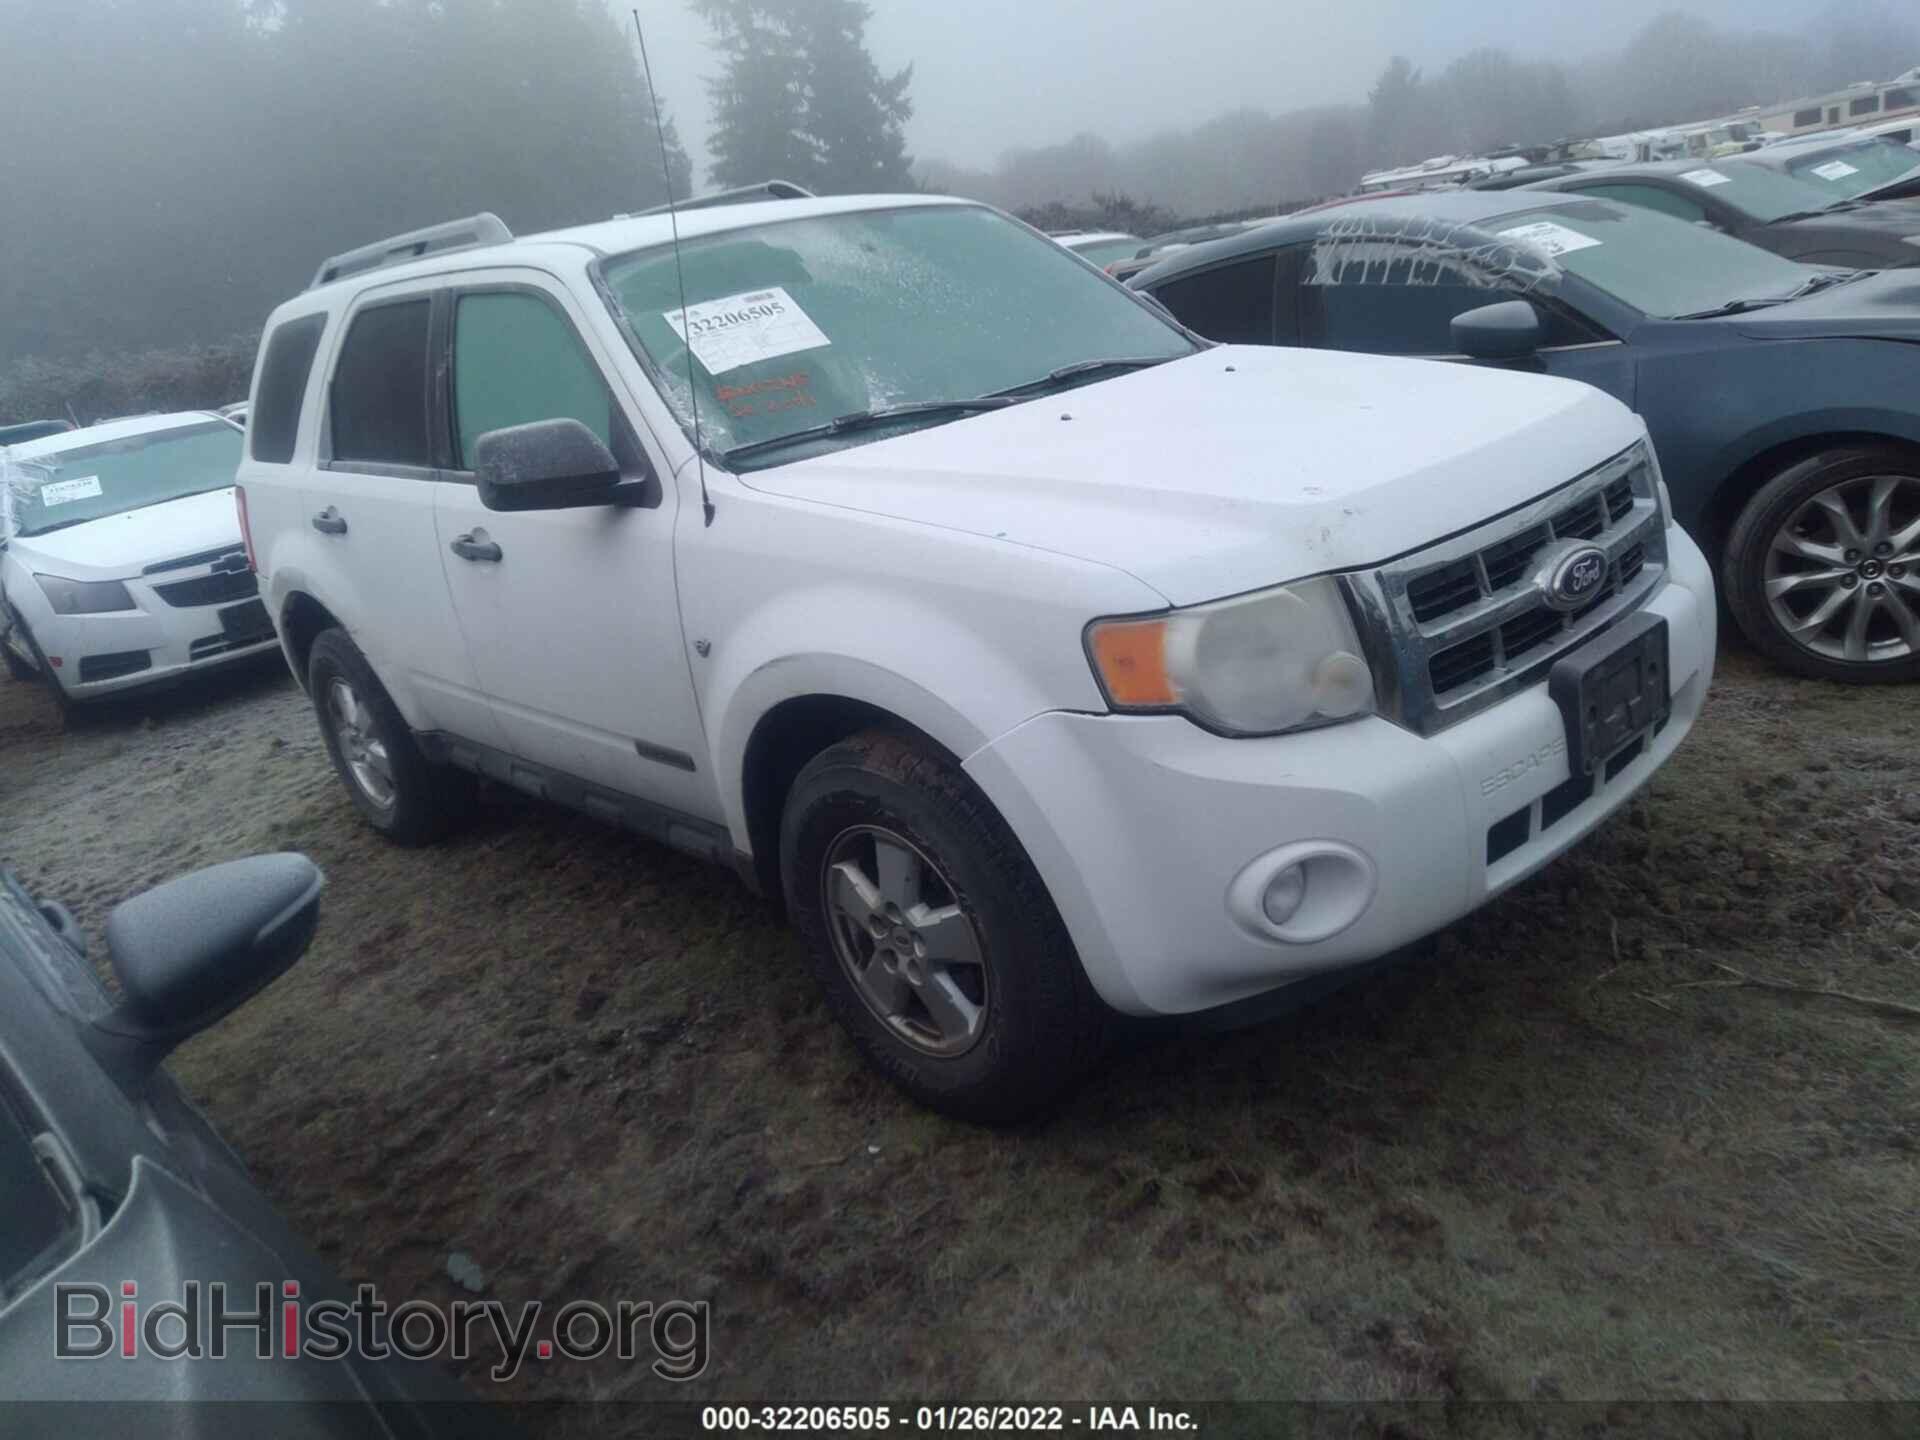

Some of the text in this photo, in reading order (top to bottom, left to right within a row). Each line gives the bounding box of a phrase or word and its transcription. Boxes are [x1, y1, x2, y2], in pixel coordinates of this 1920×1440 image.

[688, 302, 785, 335] 32206505
[1572, 558, 1600, 591] Ford
[1480, 736, 1565, 797] ESCAPE
